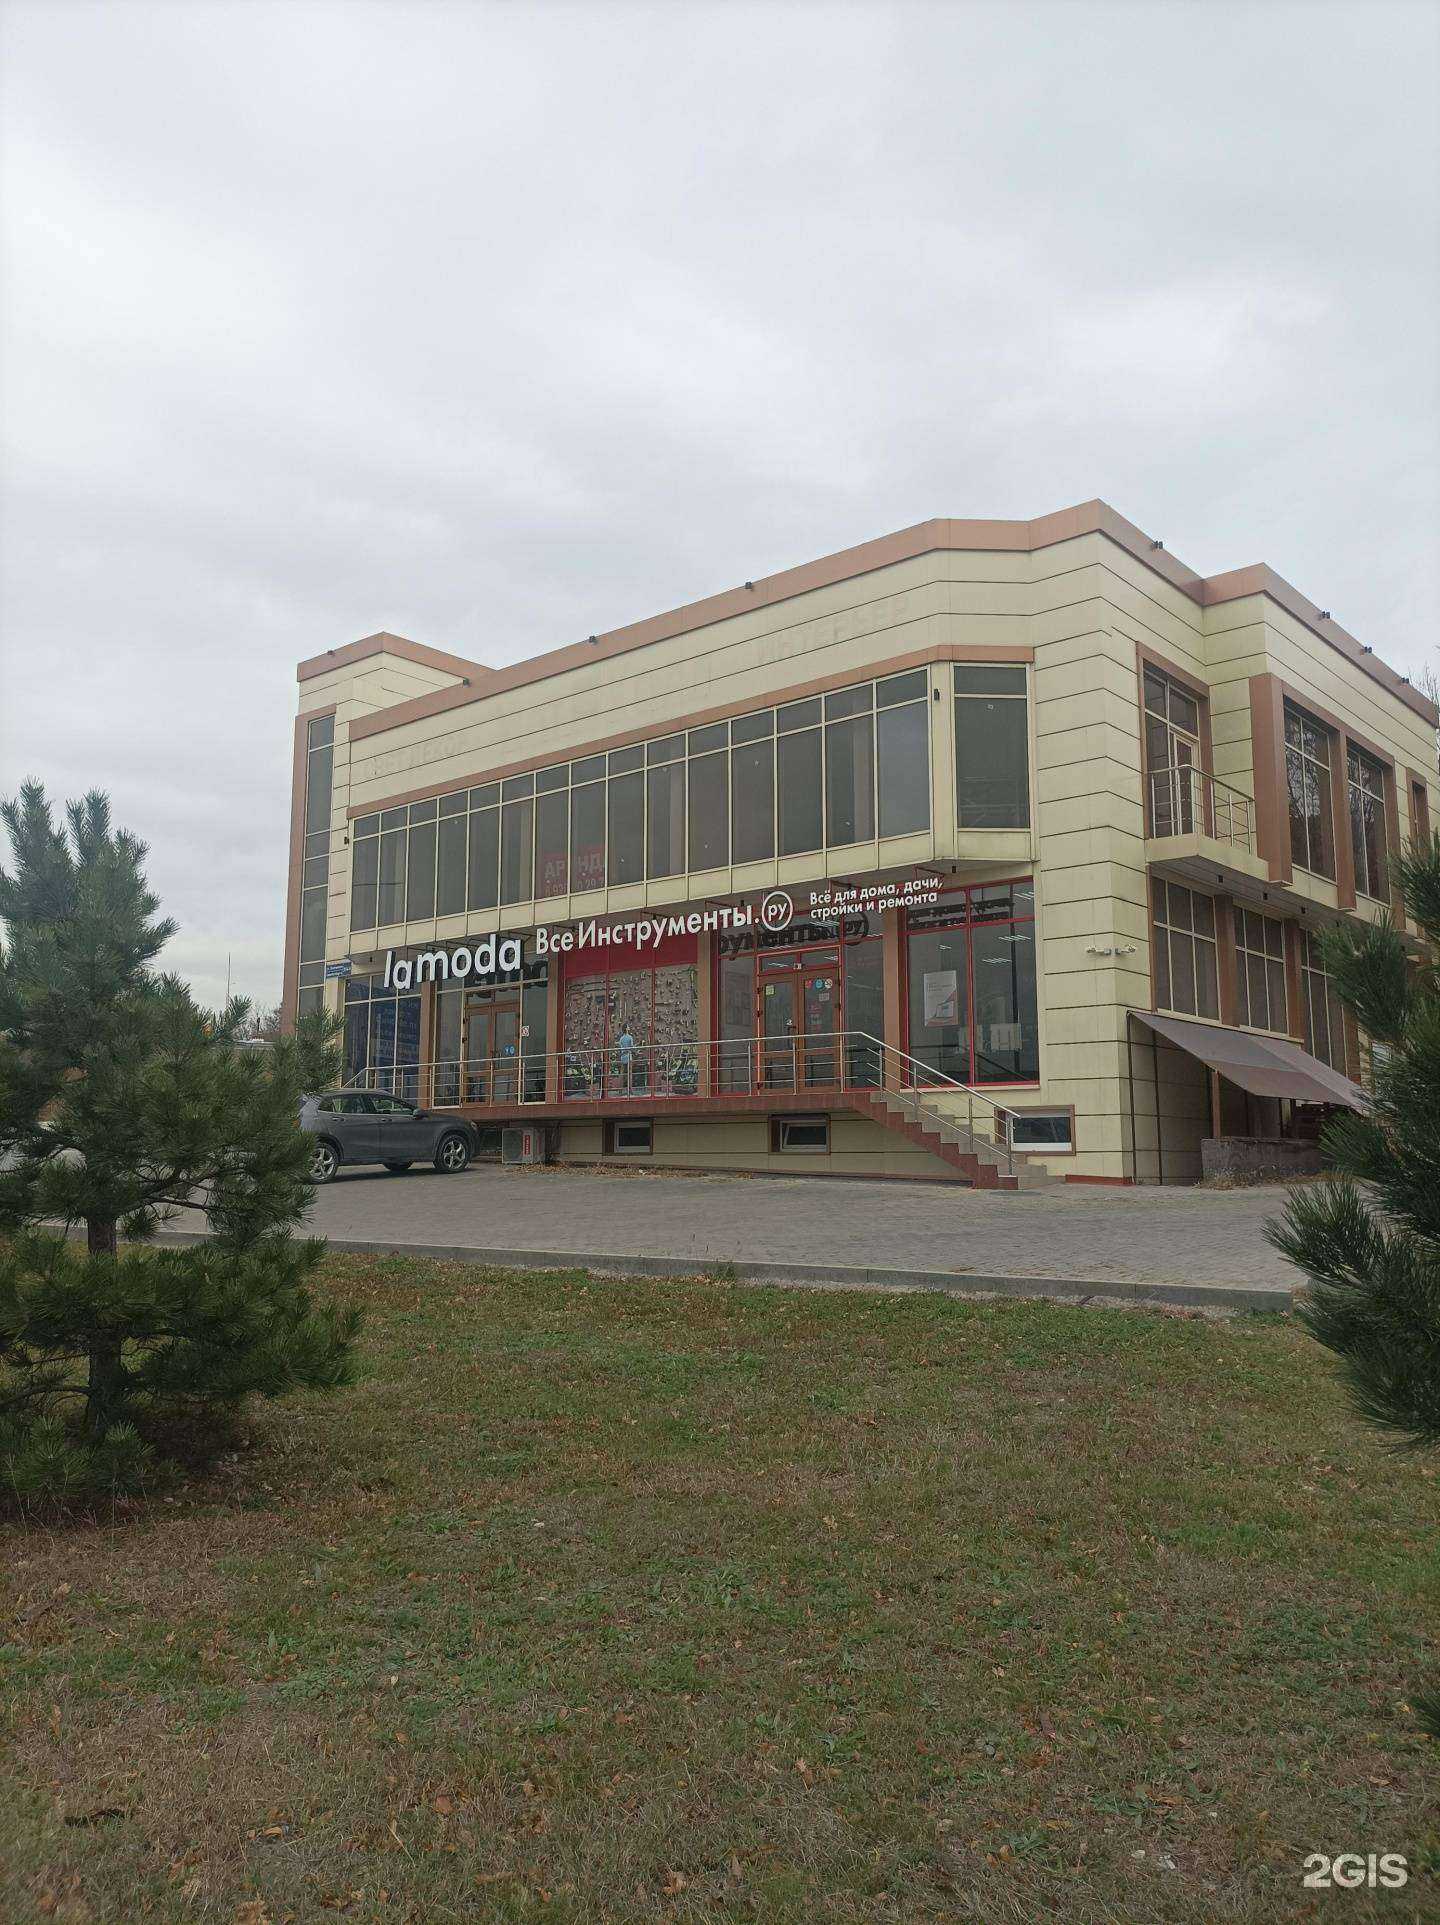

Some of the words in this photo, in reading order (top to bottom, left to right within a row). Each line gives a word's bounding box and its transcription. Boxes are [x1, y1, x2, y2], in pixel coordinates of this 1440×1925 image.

[810, 889, 831, 906] Всё
[834, 889, 857, 904] для
[860, 883, 900, 901] дома,
[904, 877, 943, 895] дачи,
[810, 901, 863, 920] стройки
[866, 901, 875, 911] и
[879, 891, 937, 913] ремонта
[383, 933, 521, 989] lamoda
